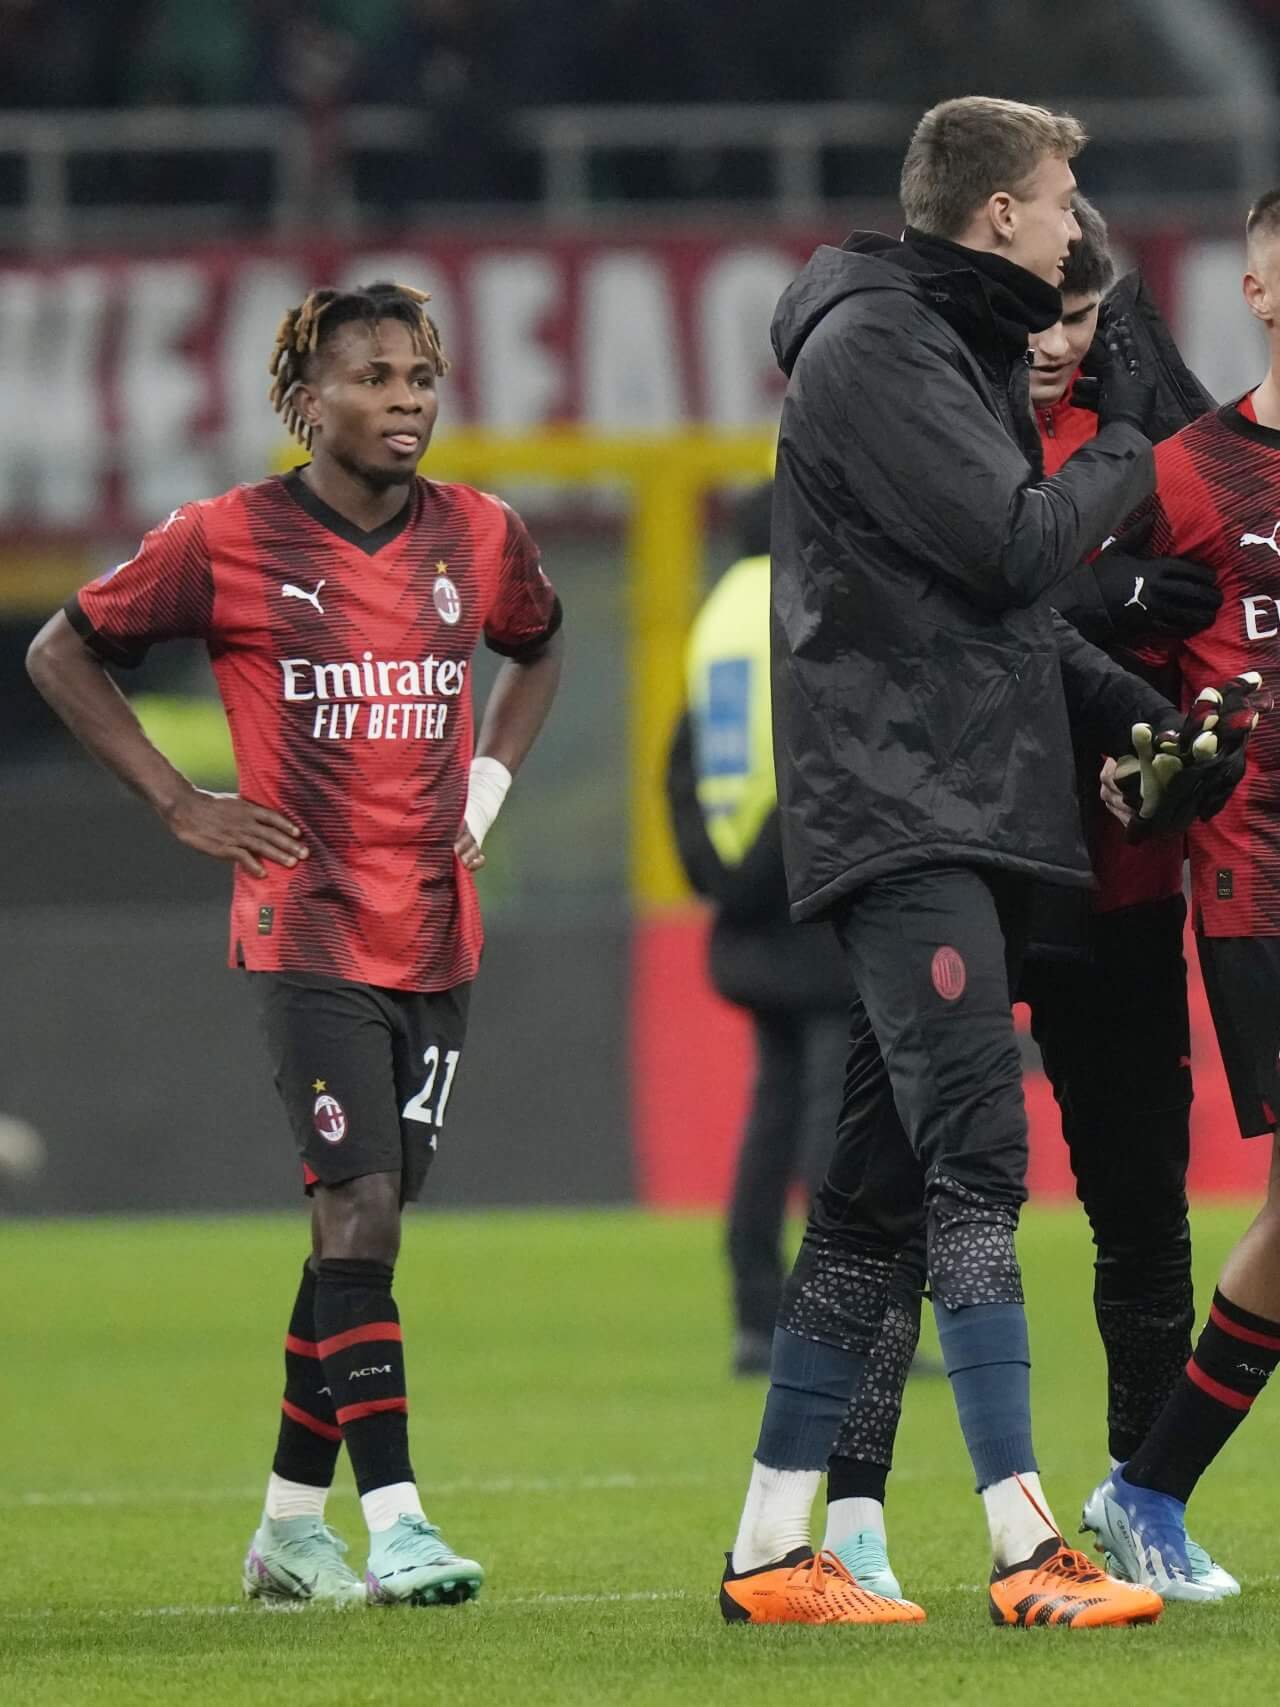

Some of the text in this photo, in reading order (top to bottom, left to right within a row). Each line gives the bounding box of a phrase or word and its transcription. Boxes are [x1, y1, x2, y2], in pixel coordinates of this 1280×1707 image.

[278, 651, 467, 701] Emirates
[313, 703, 448, 740] FLY BETTER
[402, 1046, 460, 1127] 21
[349, 1364, 392, 1380] ACM
